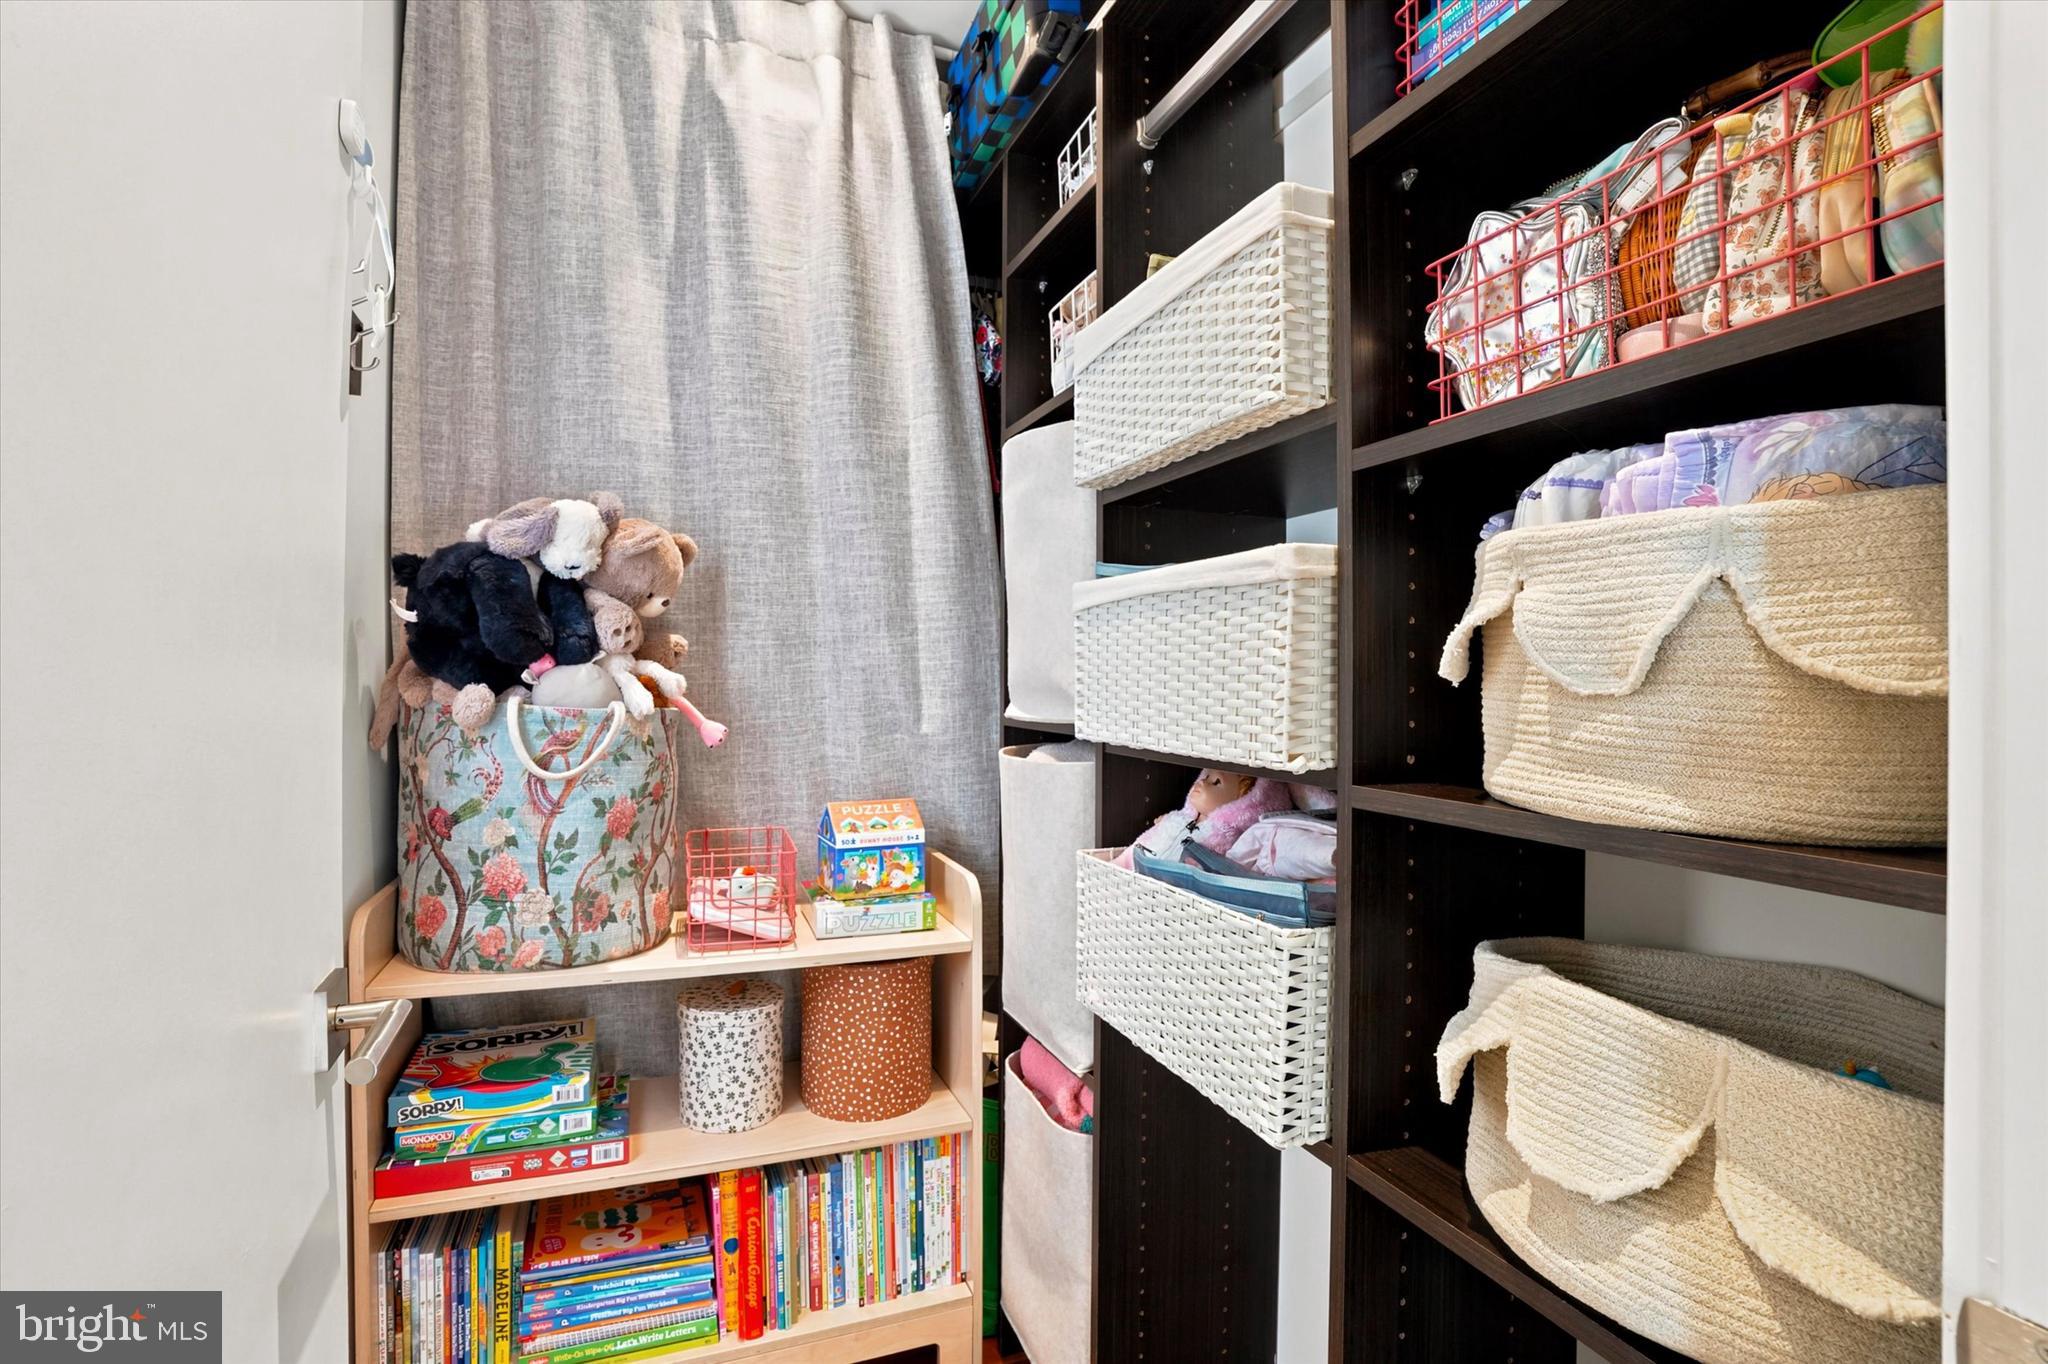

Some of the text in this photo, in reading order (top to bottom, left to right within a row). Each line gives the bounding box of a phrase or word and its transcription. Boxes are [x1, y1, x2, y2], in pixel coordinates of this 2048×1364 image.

[842, 803, 902, 815] PUZZLE
[825, 911, 917, 935] PUZZLE
[432, 1025, 578, 1055] SORRY!
[399, 1098, 461, 1121] SORRY!
[401, 1132, 454, 1145] MONOPOLY
[748, 1217, 760, 1264] Curious
[746, 1265, 761, 1307] George
[496, 1267, 509, 1343] MADELINE
[616, 1326, 697, 1350] Let's Write Letters
